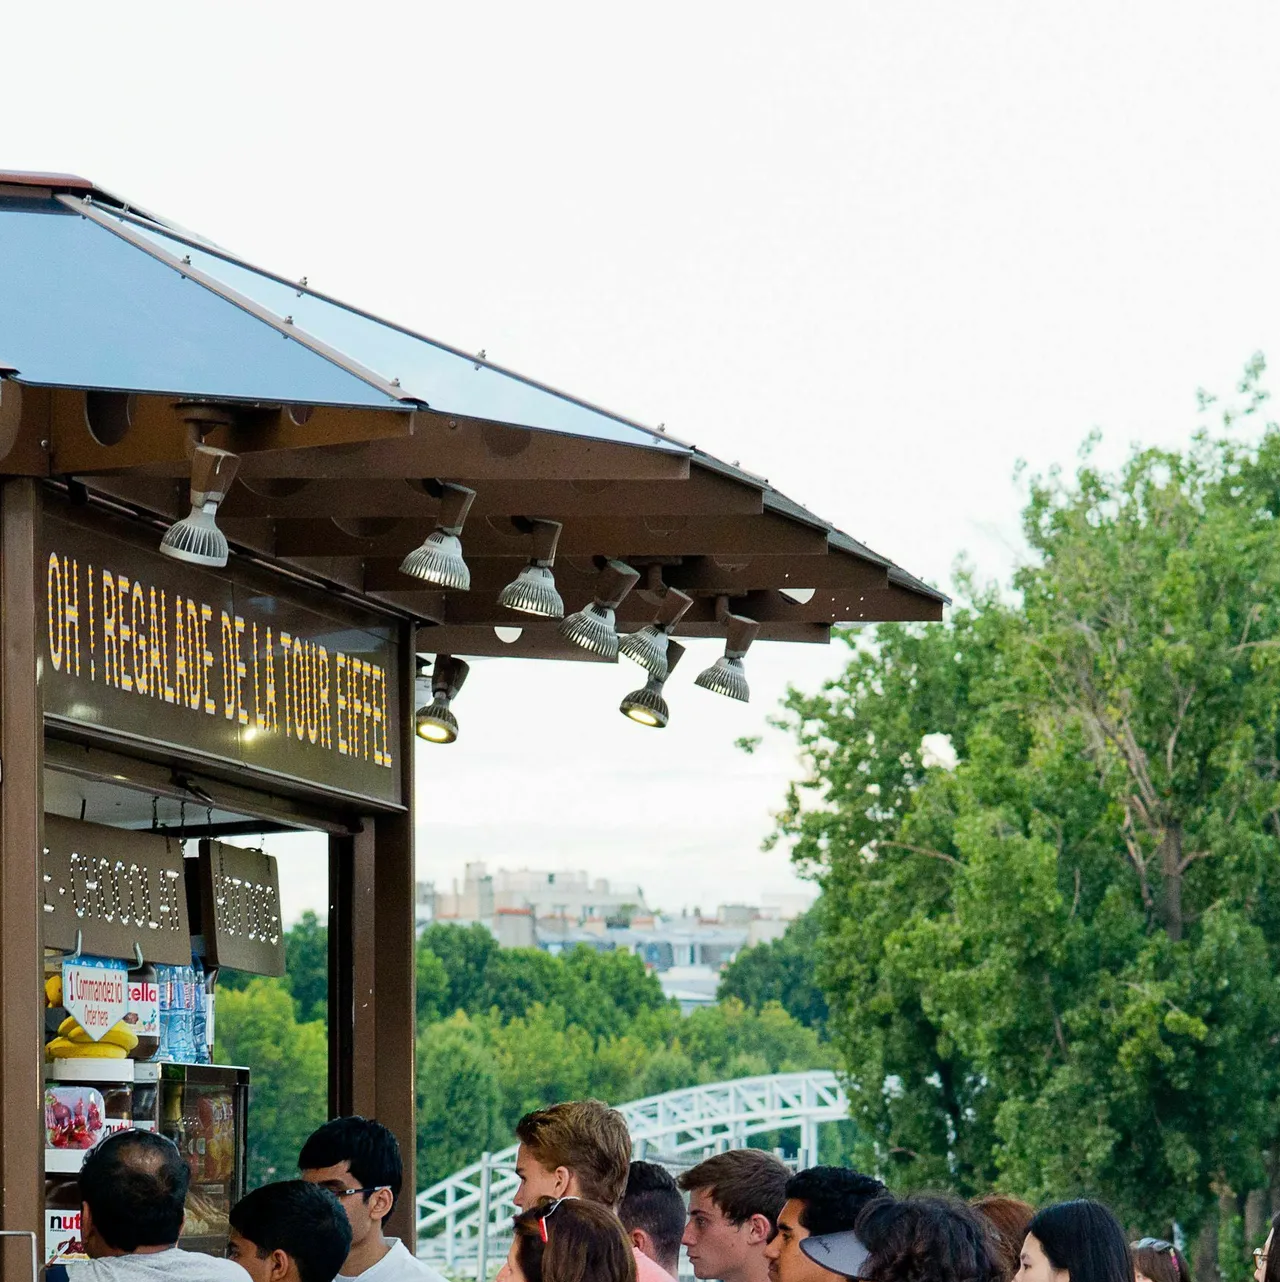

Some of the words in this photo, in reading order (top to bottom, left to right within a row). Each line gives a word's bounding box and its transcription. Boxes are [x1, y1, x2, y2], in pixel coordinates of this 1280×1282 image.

[48, 552, 79, 677] OH
[88, 565, 95, 681] !
[103, 569, 215, 714] REGALADE
[221, 610, 249, 724] DE
[252, 622, 277, 734] LA
[281, 631, 332, 750] TOUR
[337, 652, 392, 768] EIFFEL
[70, 852, 180, 931] CHOCOLAT
[214, 873, 242, 937] HOT
[68, 976, 75, 1001] 1
[76, 971, 114, 1002] Commandez
[115, 974, 123, 1003] ici
[84, 1004, 98, 1026] Order
[98, 1006, 109, 1027] here
